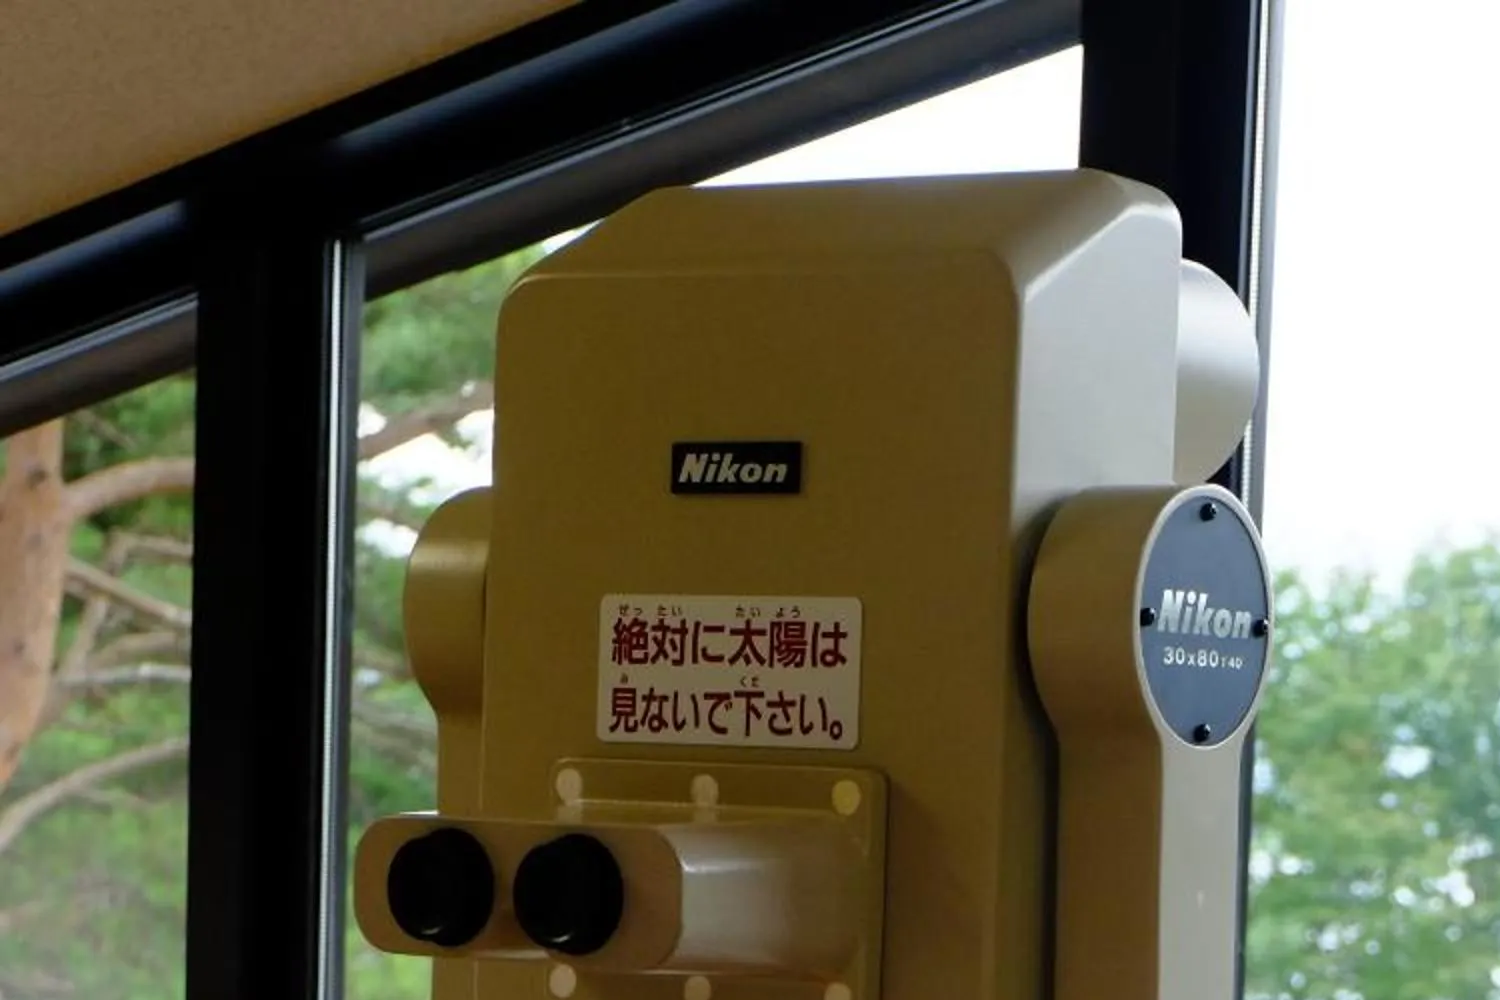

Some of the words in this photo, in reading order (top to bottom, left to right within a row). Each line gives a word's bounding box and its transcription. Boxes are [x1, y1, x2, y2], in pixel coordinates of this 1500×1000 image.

[678, 453, 788, 484] Nikon
[1157, 589, 1252, 639] Nikon
[611, 618, 848, 669] 絶対に太陽は
[609, 687, 843, 740] 見ないで下さい。
